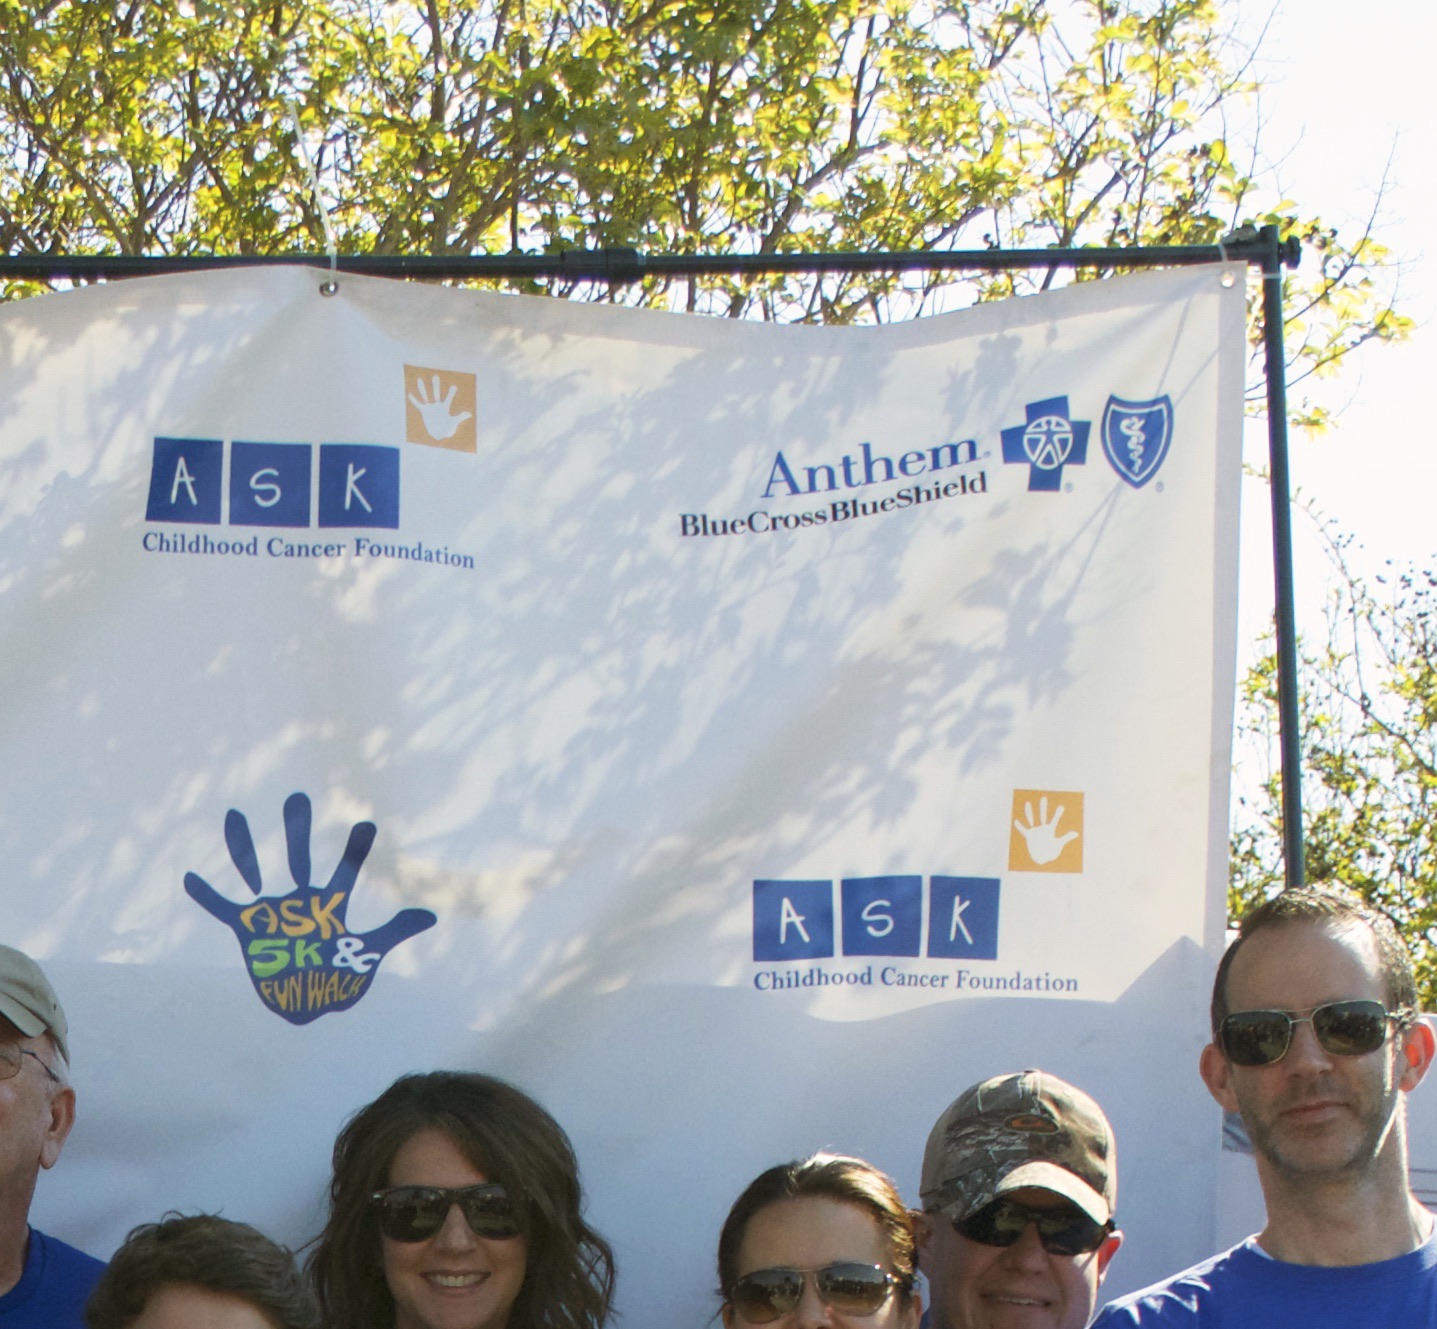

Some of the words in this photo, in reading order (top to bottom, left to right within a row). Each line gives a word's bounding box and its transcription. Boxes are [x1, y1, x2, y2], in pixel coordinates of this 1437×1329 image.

[760, 437, 979, 499] Anthem
[142, 531, 258, 557] Childhood
[266, 537, 346, 559] Cancer
[355, 538, 475, 569] Foundation
[240, 892, 346, 940] ASK
[260, 972, 302, 1012] FUN
[753, 966, 872, 991] Childhood
[880, 967, 949, 989] Cancer
[956, 970, 1079, 992] Foundation
